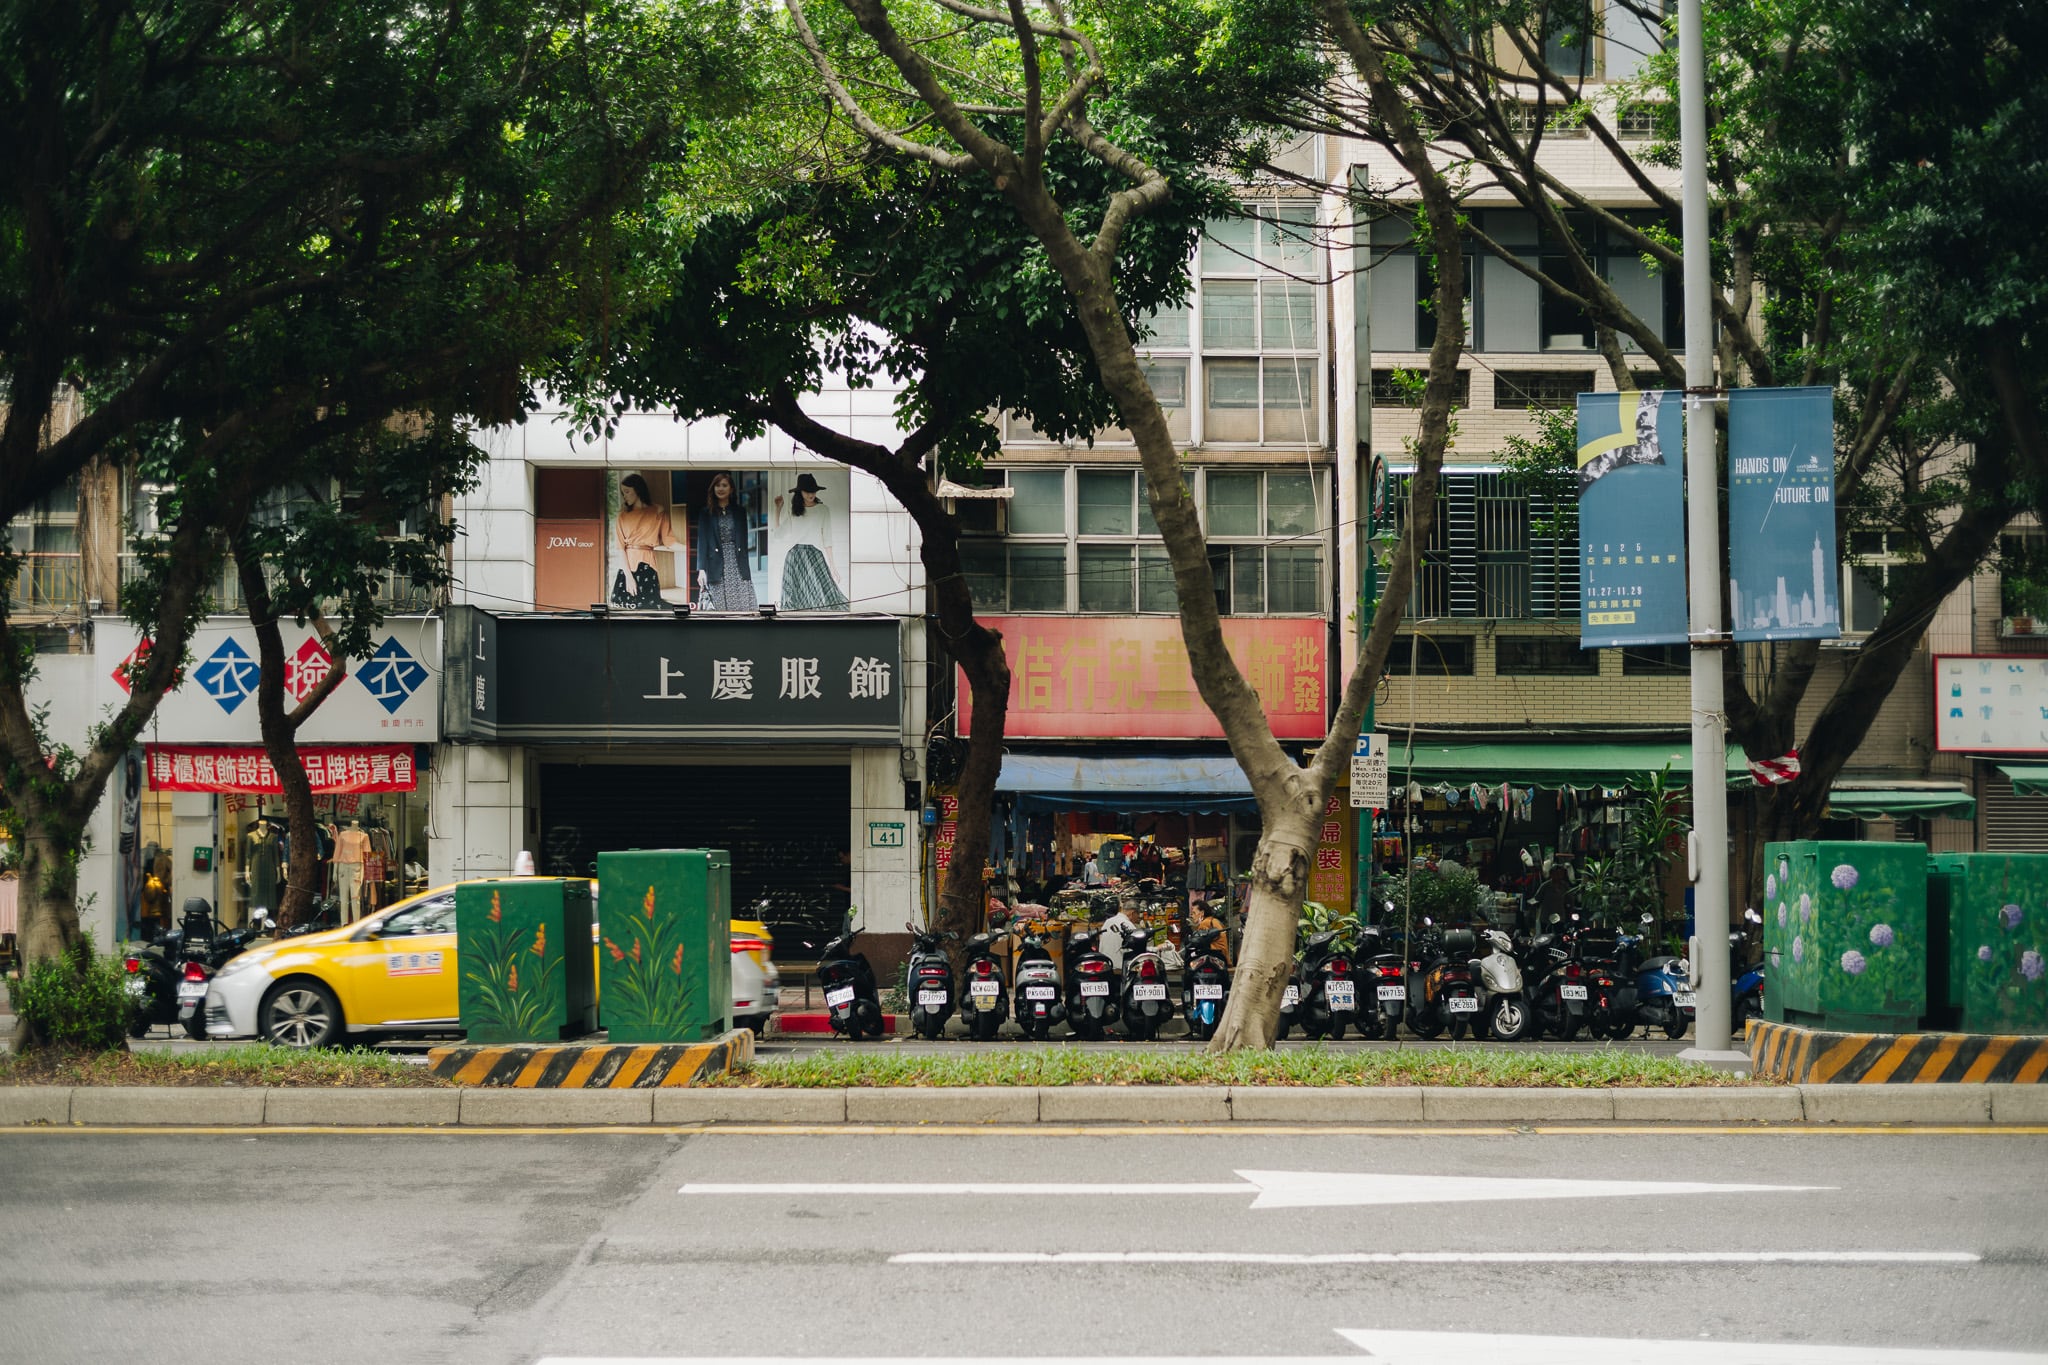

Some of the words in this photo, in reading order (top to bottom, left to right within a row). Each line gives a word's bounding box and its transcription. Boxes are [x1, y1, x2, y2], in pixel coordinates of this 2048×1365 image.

[1735, 457, 1769, 474] HANDS
[1773, 457, 1787, 473] ON
[1775, 487, 1811, 503] FUTURE
[1815, 486, 1829, 502] ON
[546, 537, 577, 549] JOAN
[1587, 586, 1642, 597] 11.27-11.29
[475, 623, 486, 711] 上慶
[1292, 636, 1320, 713] 批發
[642, 656, 892, 700] 上慶服飾
[1356, 739, 1367, 754] P
[151, 751, 413, 787] 專櫃服飾設計品牌特賣會
[879, 831, 896, 844] 41
